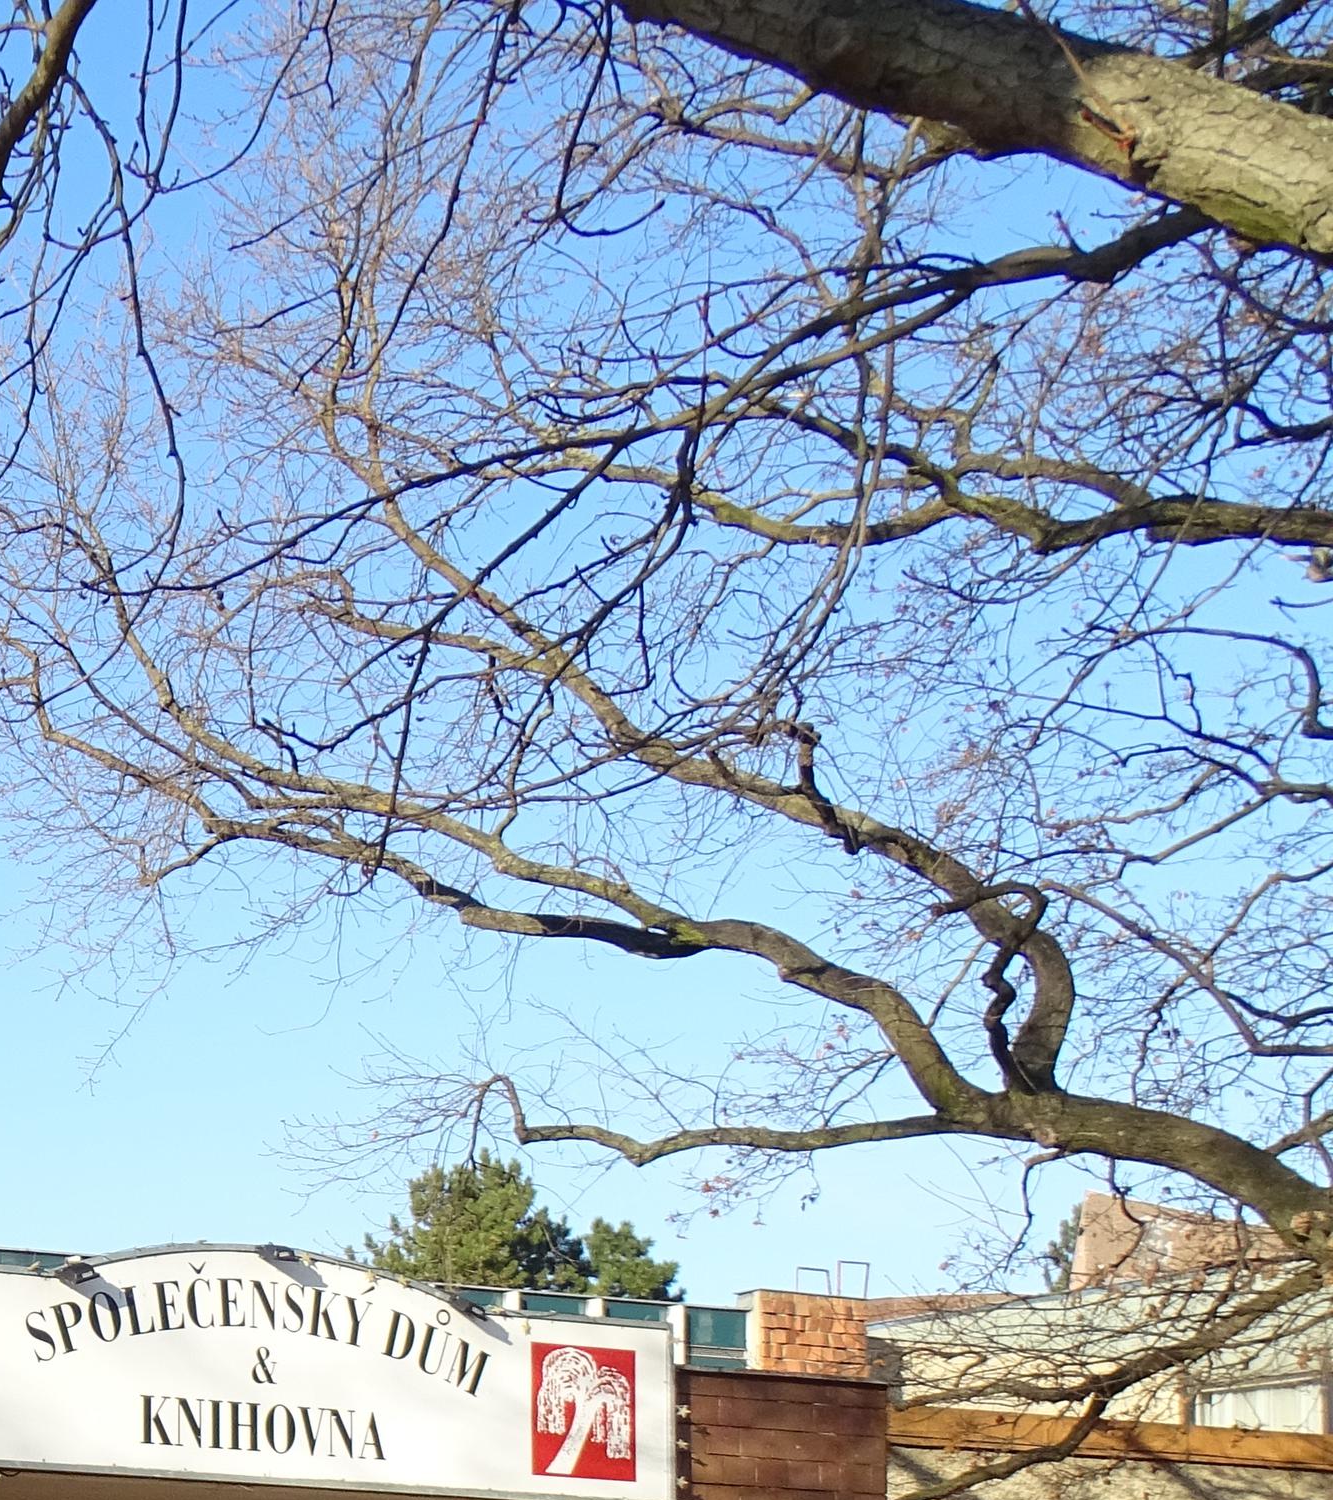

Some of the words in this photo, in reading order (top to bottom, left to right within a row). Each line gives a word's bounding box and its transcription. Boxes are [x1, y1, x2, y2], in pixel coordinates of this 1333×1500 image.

[24, 1261, 375, 1363] SPOLEČENSKÝ
[380, 1308, 491, 1397] DŮM
[250, 1346, 278, 1385] &
[139, 1394, 387, 1460] KNIHOVNA
